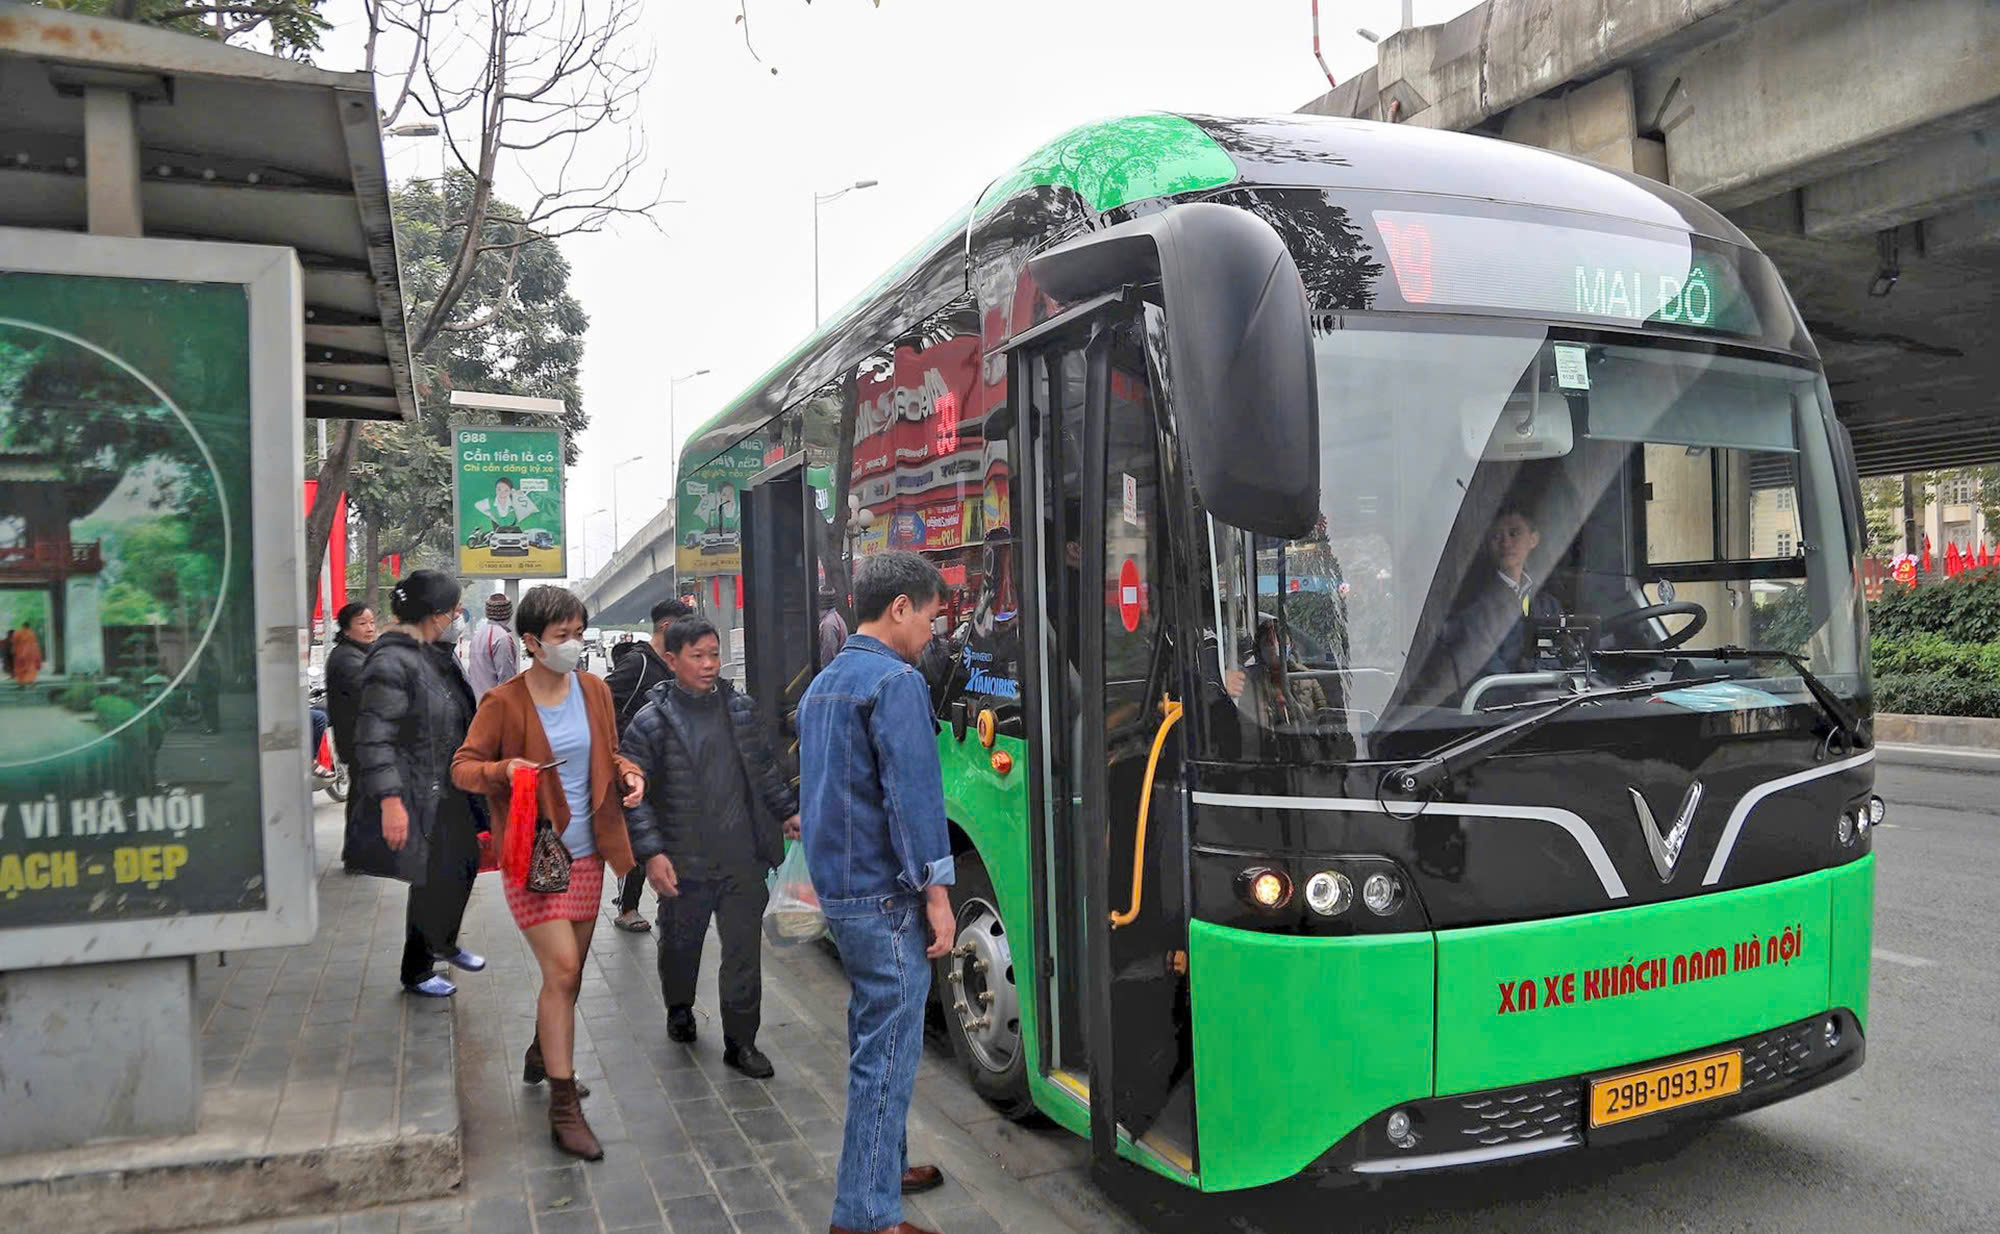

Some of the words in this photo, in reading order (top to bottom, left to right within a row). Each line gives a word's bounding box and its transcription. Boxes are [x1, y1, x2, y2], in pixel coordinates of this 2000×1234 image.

[1575, 265, 1641, 318] MAI
[463, 448, 491, 461] Cần
[494, 449, 518, 462] tiền
[521, 451, 534, 462] là
[537, 451, 554, 462] có
[20, 794, 59, 839] VÌ
[71, 790, 129, 836] HÀ
[136, 787, 206, 838] NỘI
[114, 844, 189, 890] ĐẸP
[1498, 979, 1536, 1014] XN
[1544, 973, 1576, 1008] XE
[1584, 956, 1667, 1001] KHÁCH
[1672, 947, 1727, 985] NAM
[1734, 934, 1760, 971] HÀ
[1606, 1061, 1730, 1116] 29B-093.97
